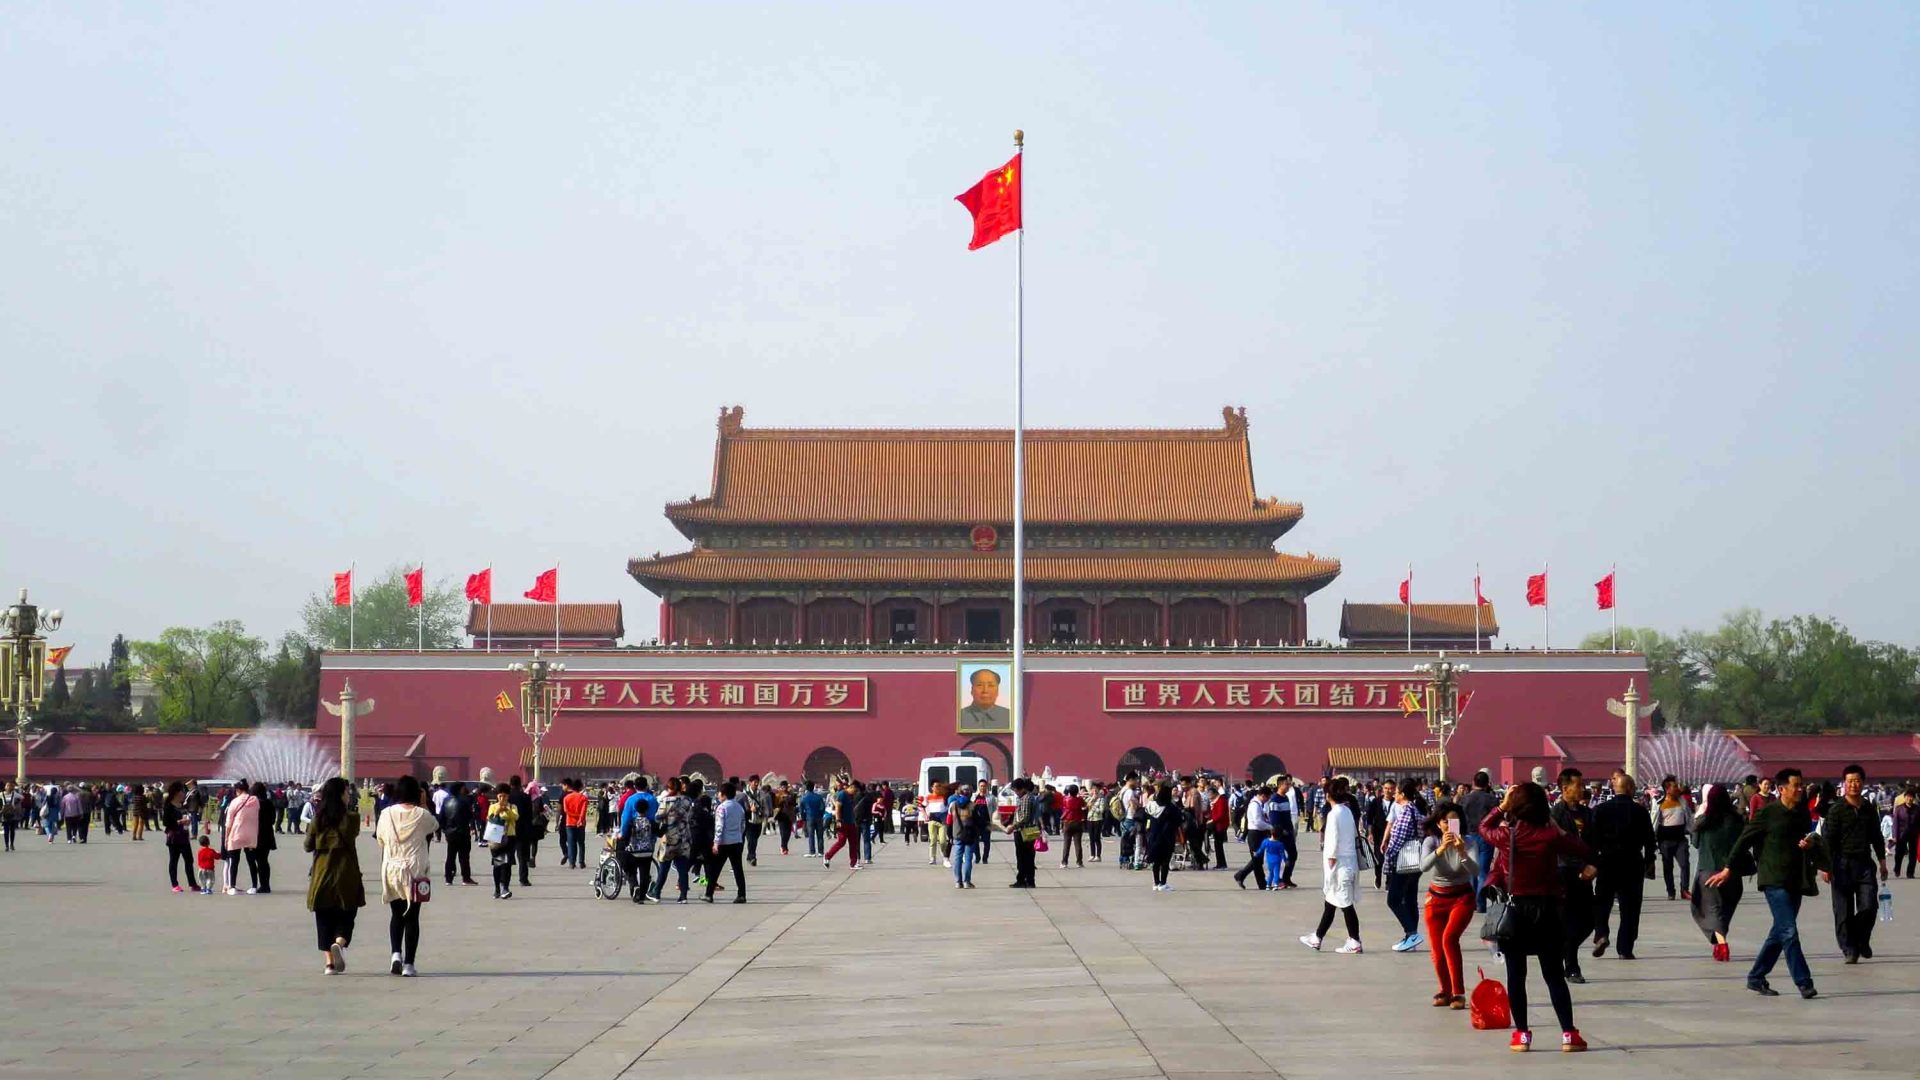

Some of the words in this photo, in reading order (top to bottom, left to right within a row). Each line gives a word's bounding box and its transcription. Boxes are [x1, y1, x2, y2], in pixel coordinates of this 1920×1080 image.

[551, 682, 849, 705] 中华人民共和国万岁
